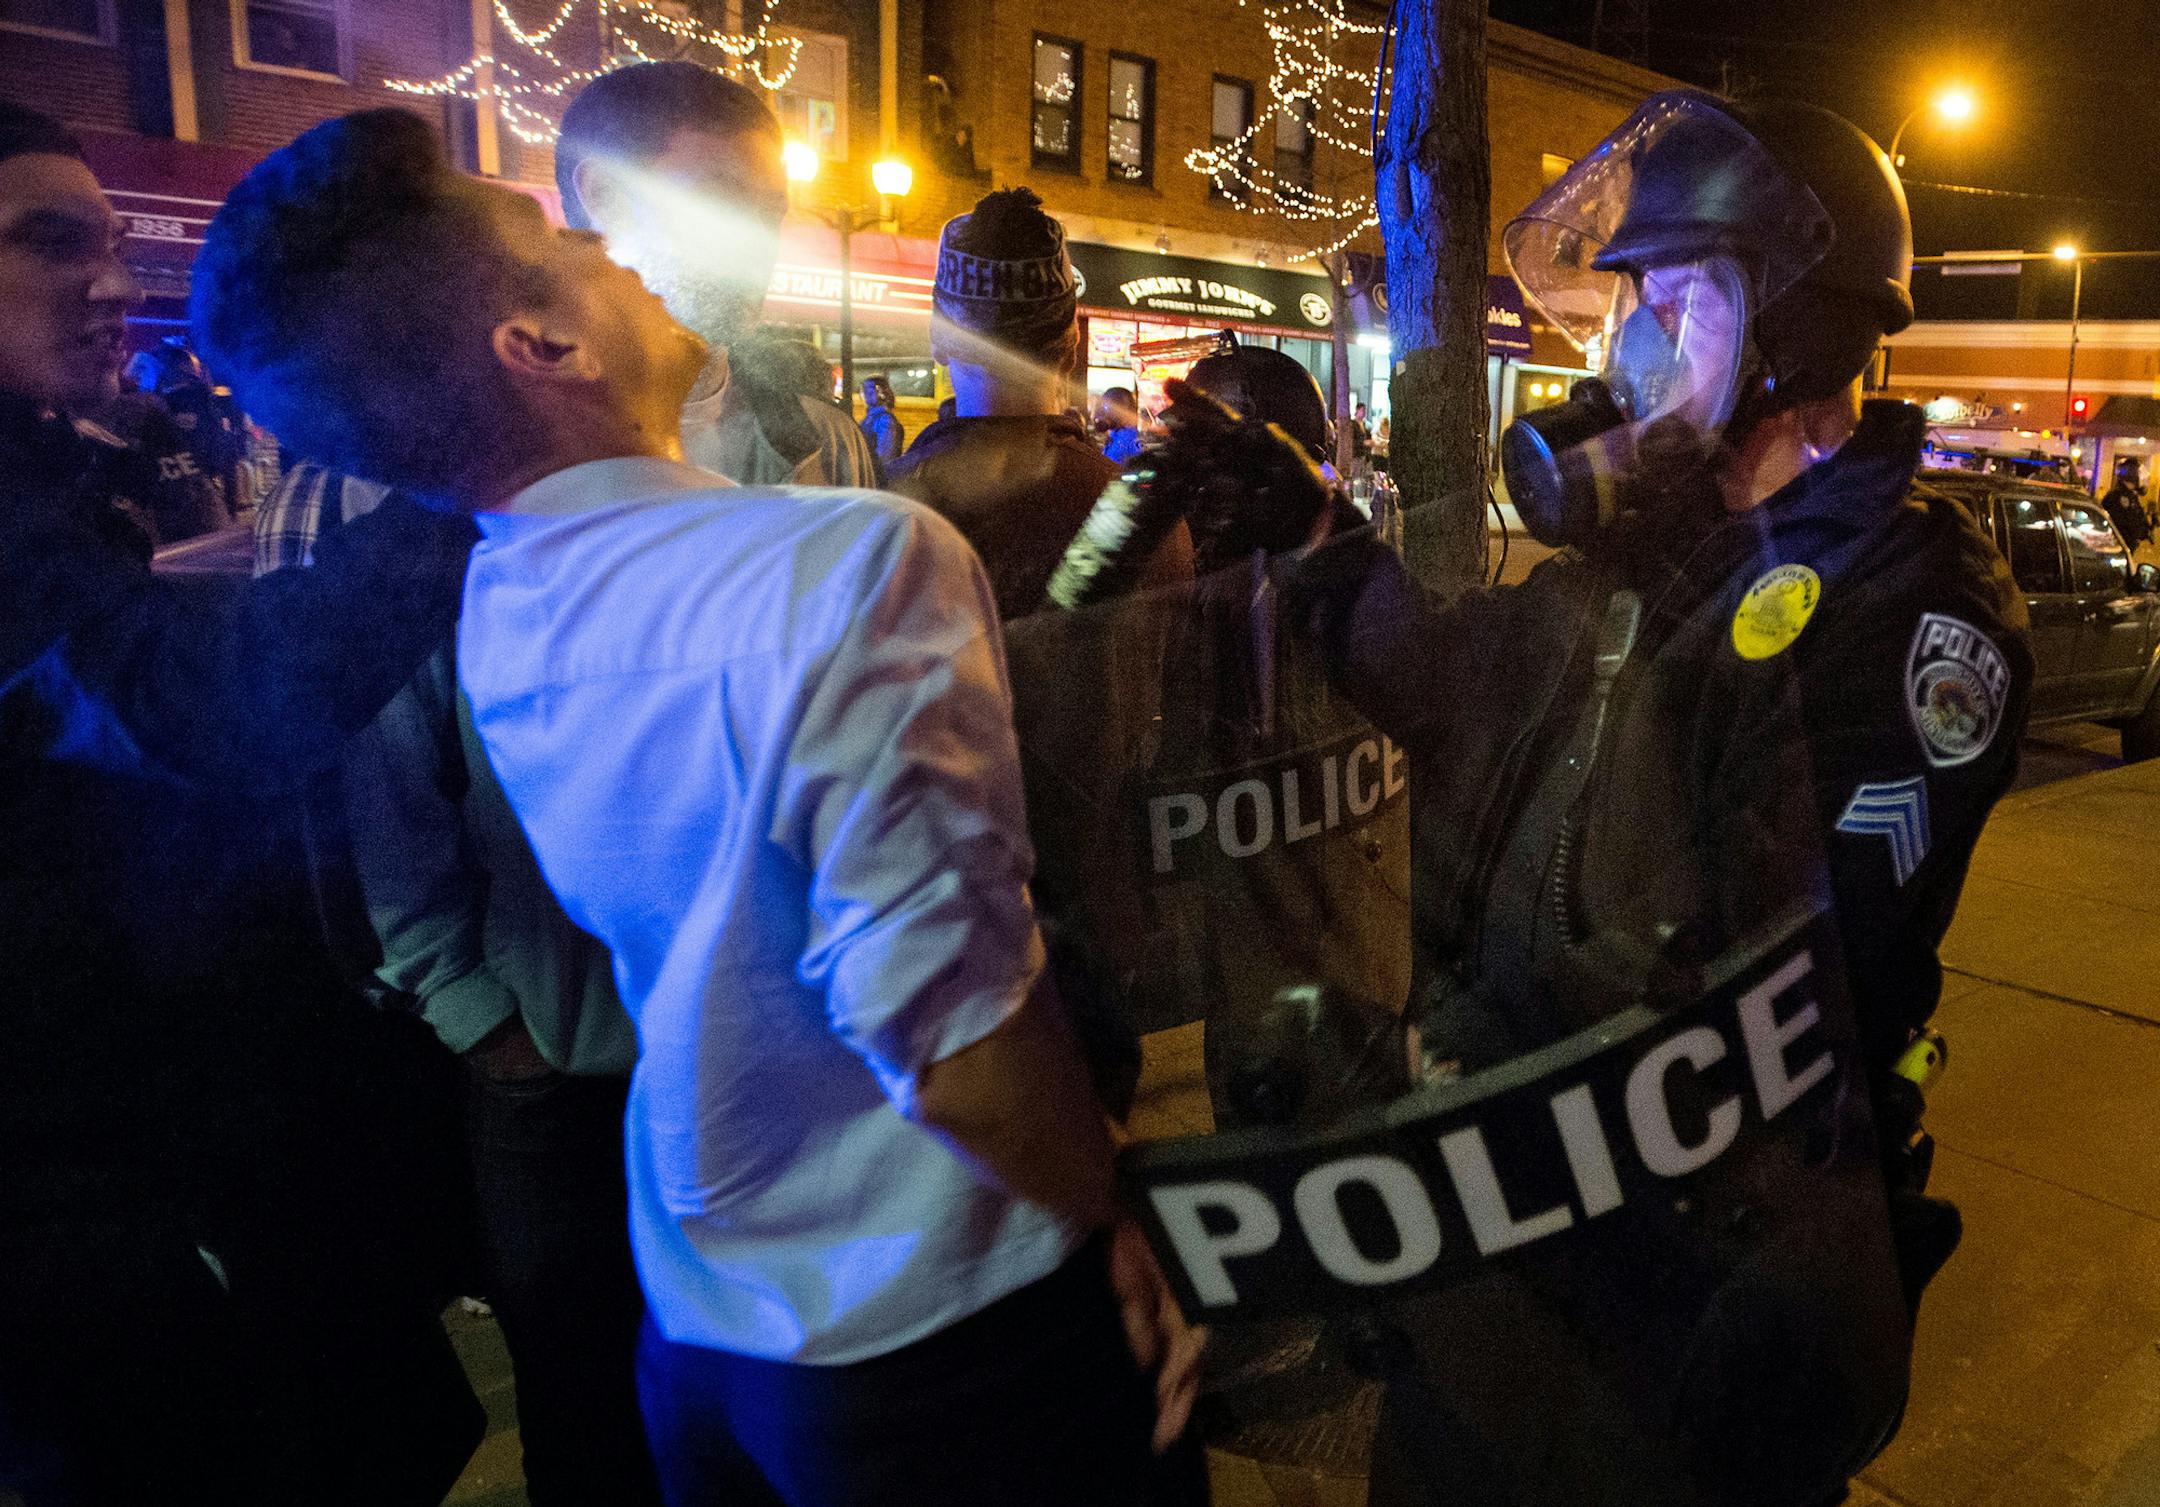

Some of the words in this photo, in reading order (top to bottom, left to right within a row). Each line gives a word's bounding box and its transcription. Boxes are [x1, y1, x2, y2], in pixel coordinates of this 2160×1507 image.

[1120, 277, 1192, 305] JIMMY
[1148, 298, 1195, 312] GOURMET
[1196, 303, 1255, 318] SANDWICHES
[1921, 622, 2003, 707] POLICE
[1149, 733, 1405, 873] POLICE
[1148, 950, 1836, 1308] POLICE
